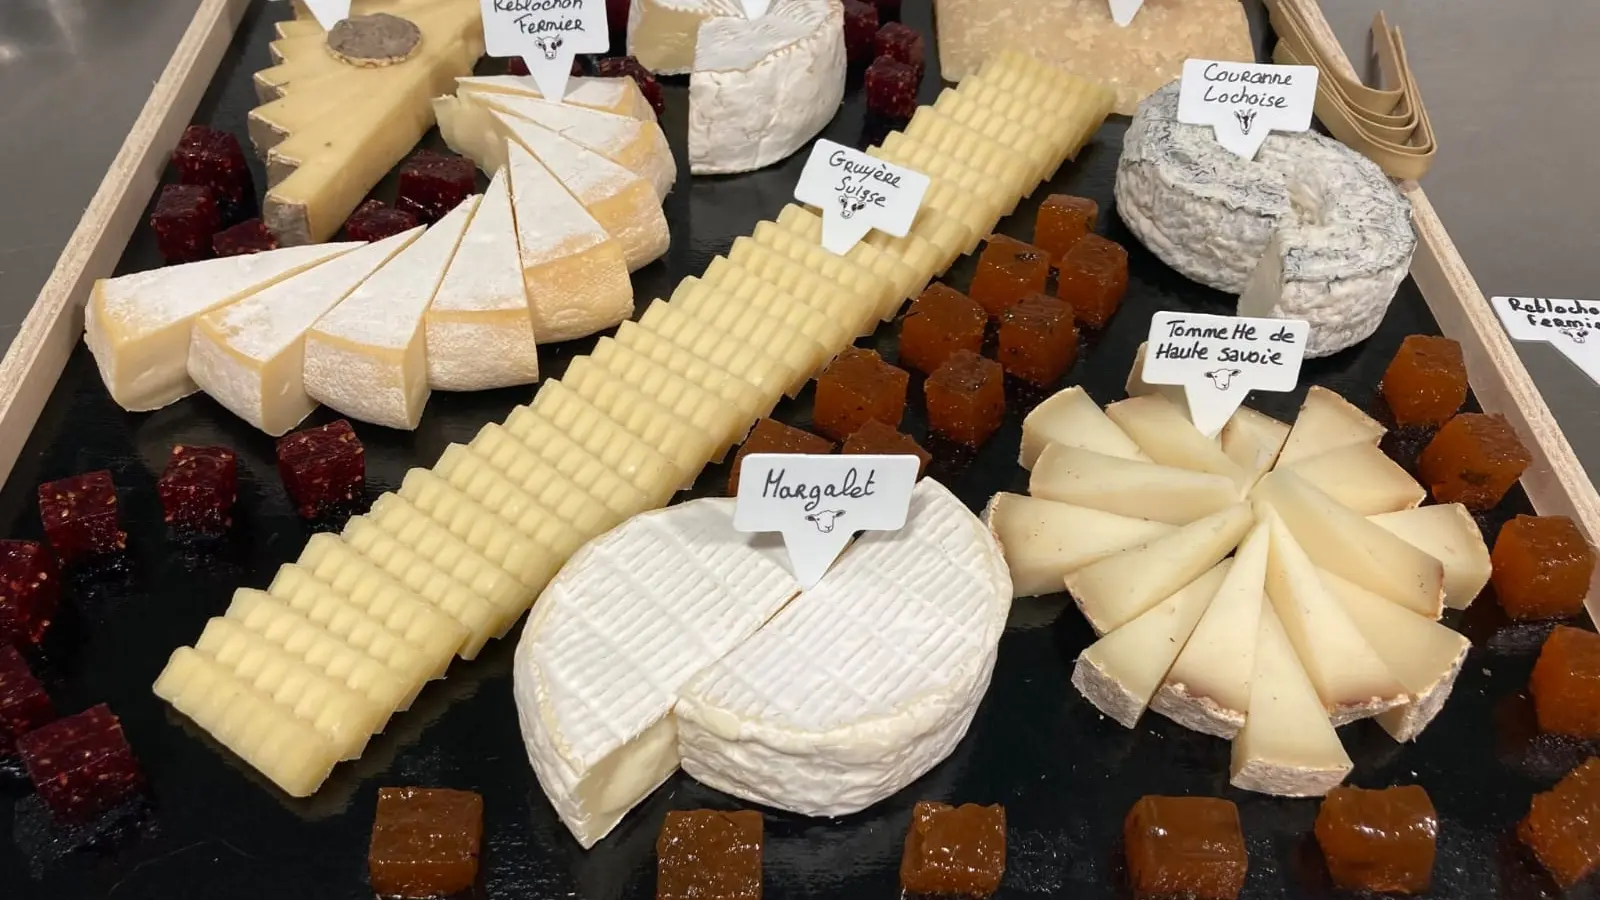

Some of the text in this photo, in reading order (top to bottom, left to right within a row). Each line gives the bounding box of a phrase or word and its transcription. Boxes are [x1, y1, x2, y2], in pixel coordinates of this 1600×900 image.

[1203, 85, 1288, 108] Lochoise
[829, 150, 901, 188] Gruyère
[1508, 297, 1600, 315] Reblocho
[1269, 326, 1295, 343] de
[1155, 341, 1209, 360] Haute
[762, 467, 876, 512] Margalet
